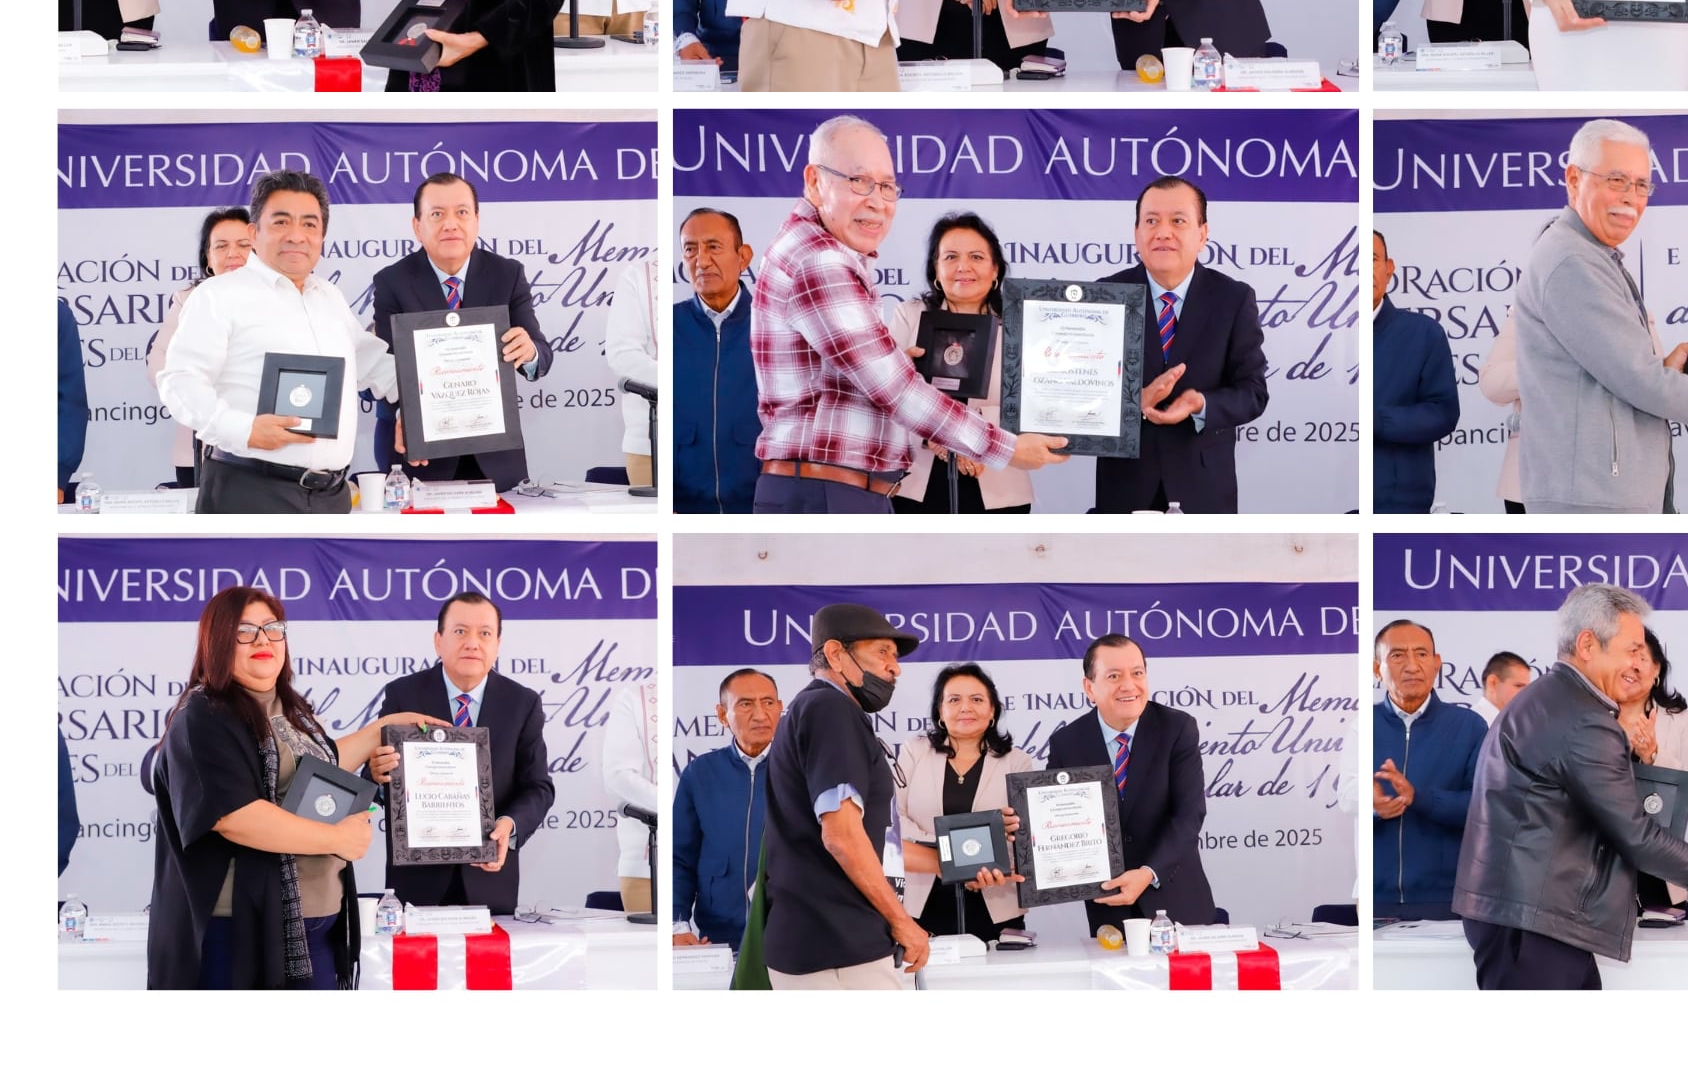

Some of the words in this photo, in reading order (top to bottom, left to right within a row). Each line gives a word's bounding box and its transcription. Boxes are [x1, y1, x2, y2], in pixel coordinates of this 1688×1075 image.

[329, 141, 599, 184] AUTÓNOMA
[1045, 126, 1358, 178] AUTÓNOMA
[509, 238, 548, 256] DEL
[1250, 247, 1295, 266] DEL
[1667, 248, 1680, 265] E
[110, 347, 144, 362] DEL
[1286, 331, 1332, 381] de
[443, 380, 476, 389] GENARO
[468, 387, 490, 396] ROJAS
[530, 389, 558, 409] de
[564, 387, 616, 408] 2025
[1266, 421, 1297, 443] de
[1303, 420, 1359, 443] 2025
[329, 558, 603, 601] AUTÓNOMA
[621, 567, 658, 600] D
[1055, 600, 1304, 641] AUTÓNOMA
[511, 659, 551, 675] DEL
[1004, 696, 1015, 711] E
[1222, 690, 1259, 706] DEL
[103, 763, 137, 777] DEL
[1257, 756, 1296, 799] de
[566, 809, 618, 830] 2025
[1244, 830, 1270, 849] de
[1274, 828, 1323, 848] 2025
